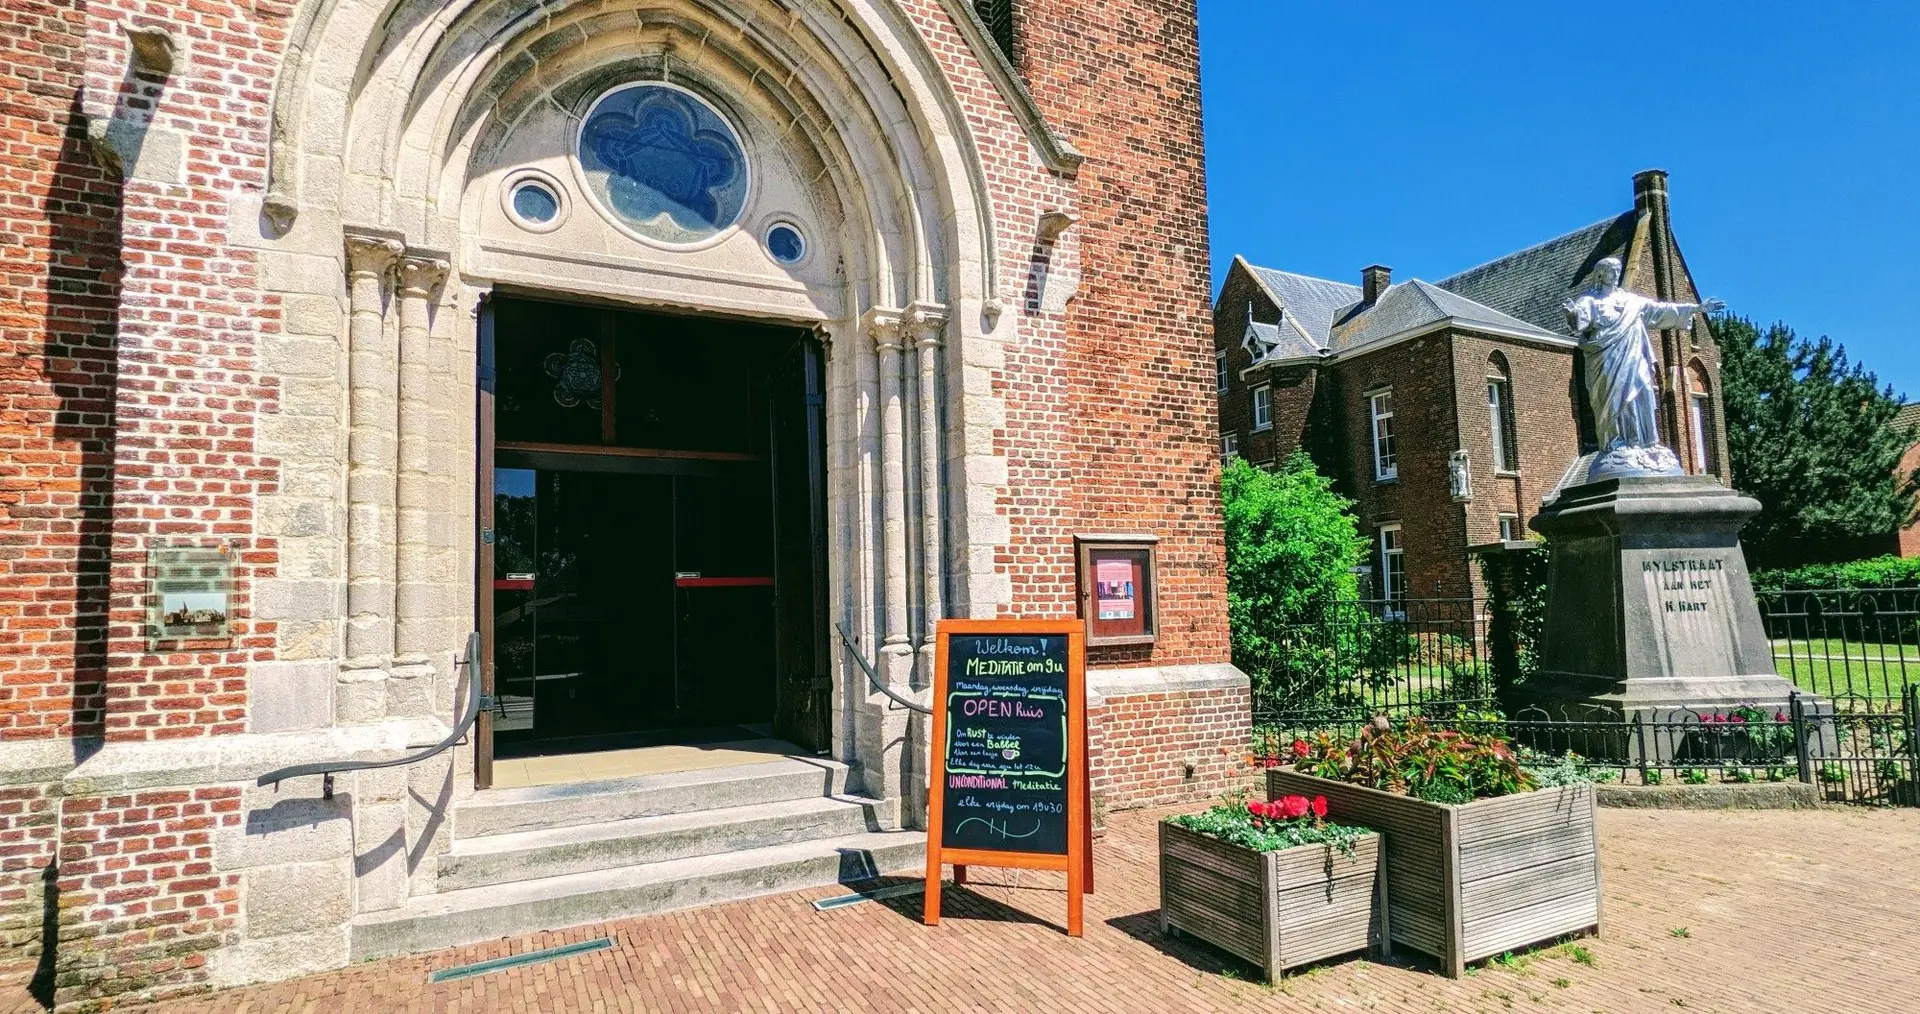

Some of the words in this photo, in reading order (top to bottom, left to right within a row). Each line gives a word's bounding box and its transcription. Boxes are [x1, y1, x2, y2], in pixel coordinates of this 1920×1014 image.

[1663, 580, 1684, 591] AAN
[1690, 579, 1712, 590] HET
[1678, 600, 1707, 612] HART
[1027, 662, 1043, 673] om
[1031, 686, 1063, 699] vrijdag
[964, 699, 1012, 717] OPEN
[1016, 701, 1044, 718] huis
[986, 739, 1021, 750] Babbel
[949, 759, 966, 767] Elke
[968, 761, 981, 770] dag
[1011, 779, 1062, 791] Meditatie
[957, 795, 981, 808] elke
[985, 799, 1014, 814] vrijdag
